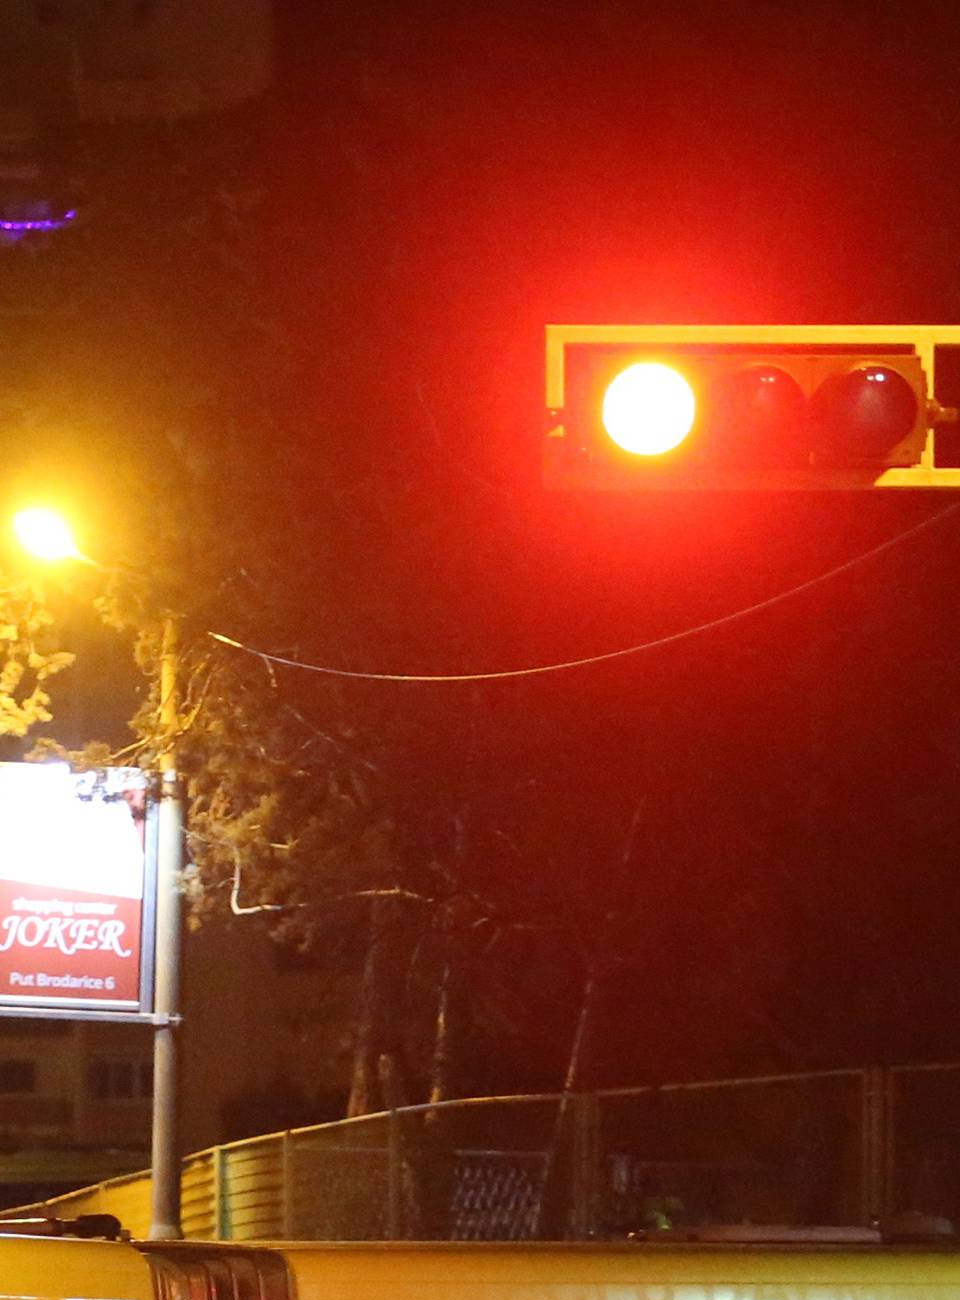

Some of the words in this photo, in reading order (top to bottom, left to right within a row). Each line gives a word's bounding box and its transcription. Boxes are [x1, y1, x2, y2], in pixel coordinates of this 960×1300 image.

[9, 971, 35, 987] Put
[36, 973, 104, 990] Brodarice
[104, 976, 116, 990] 6
